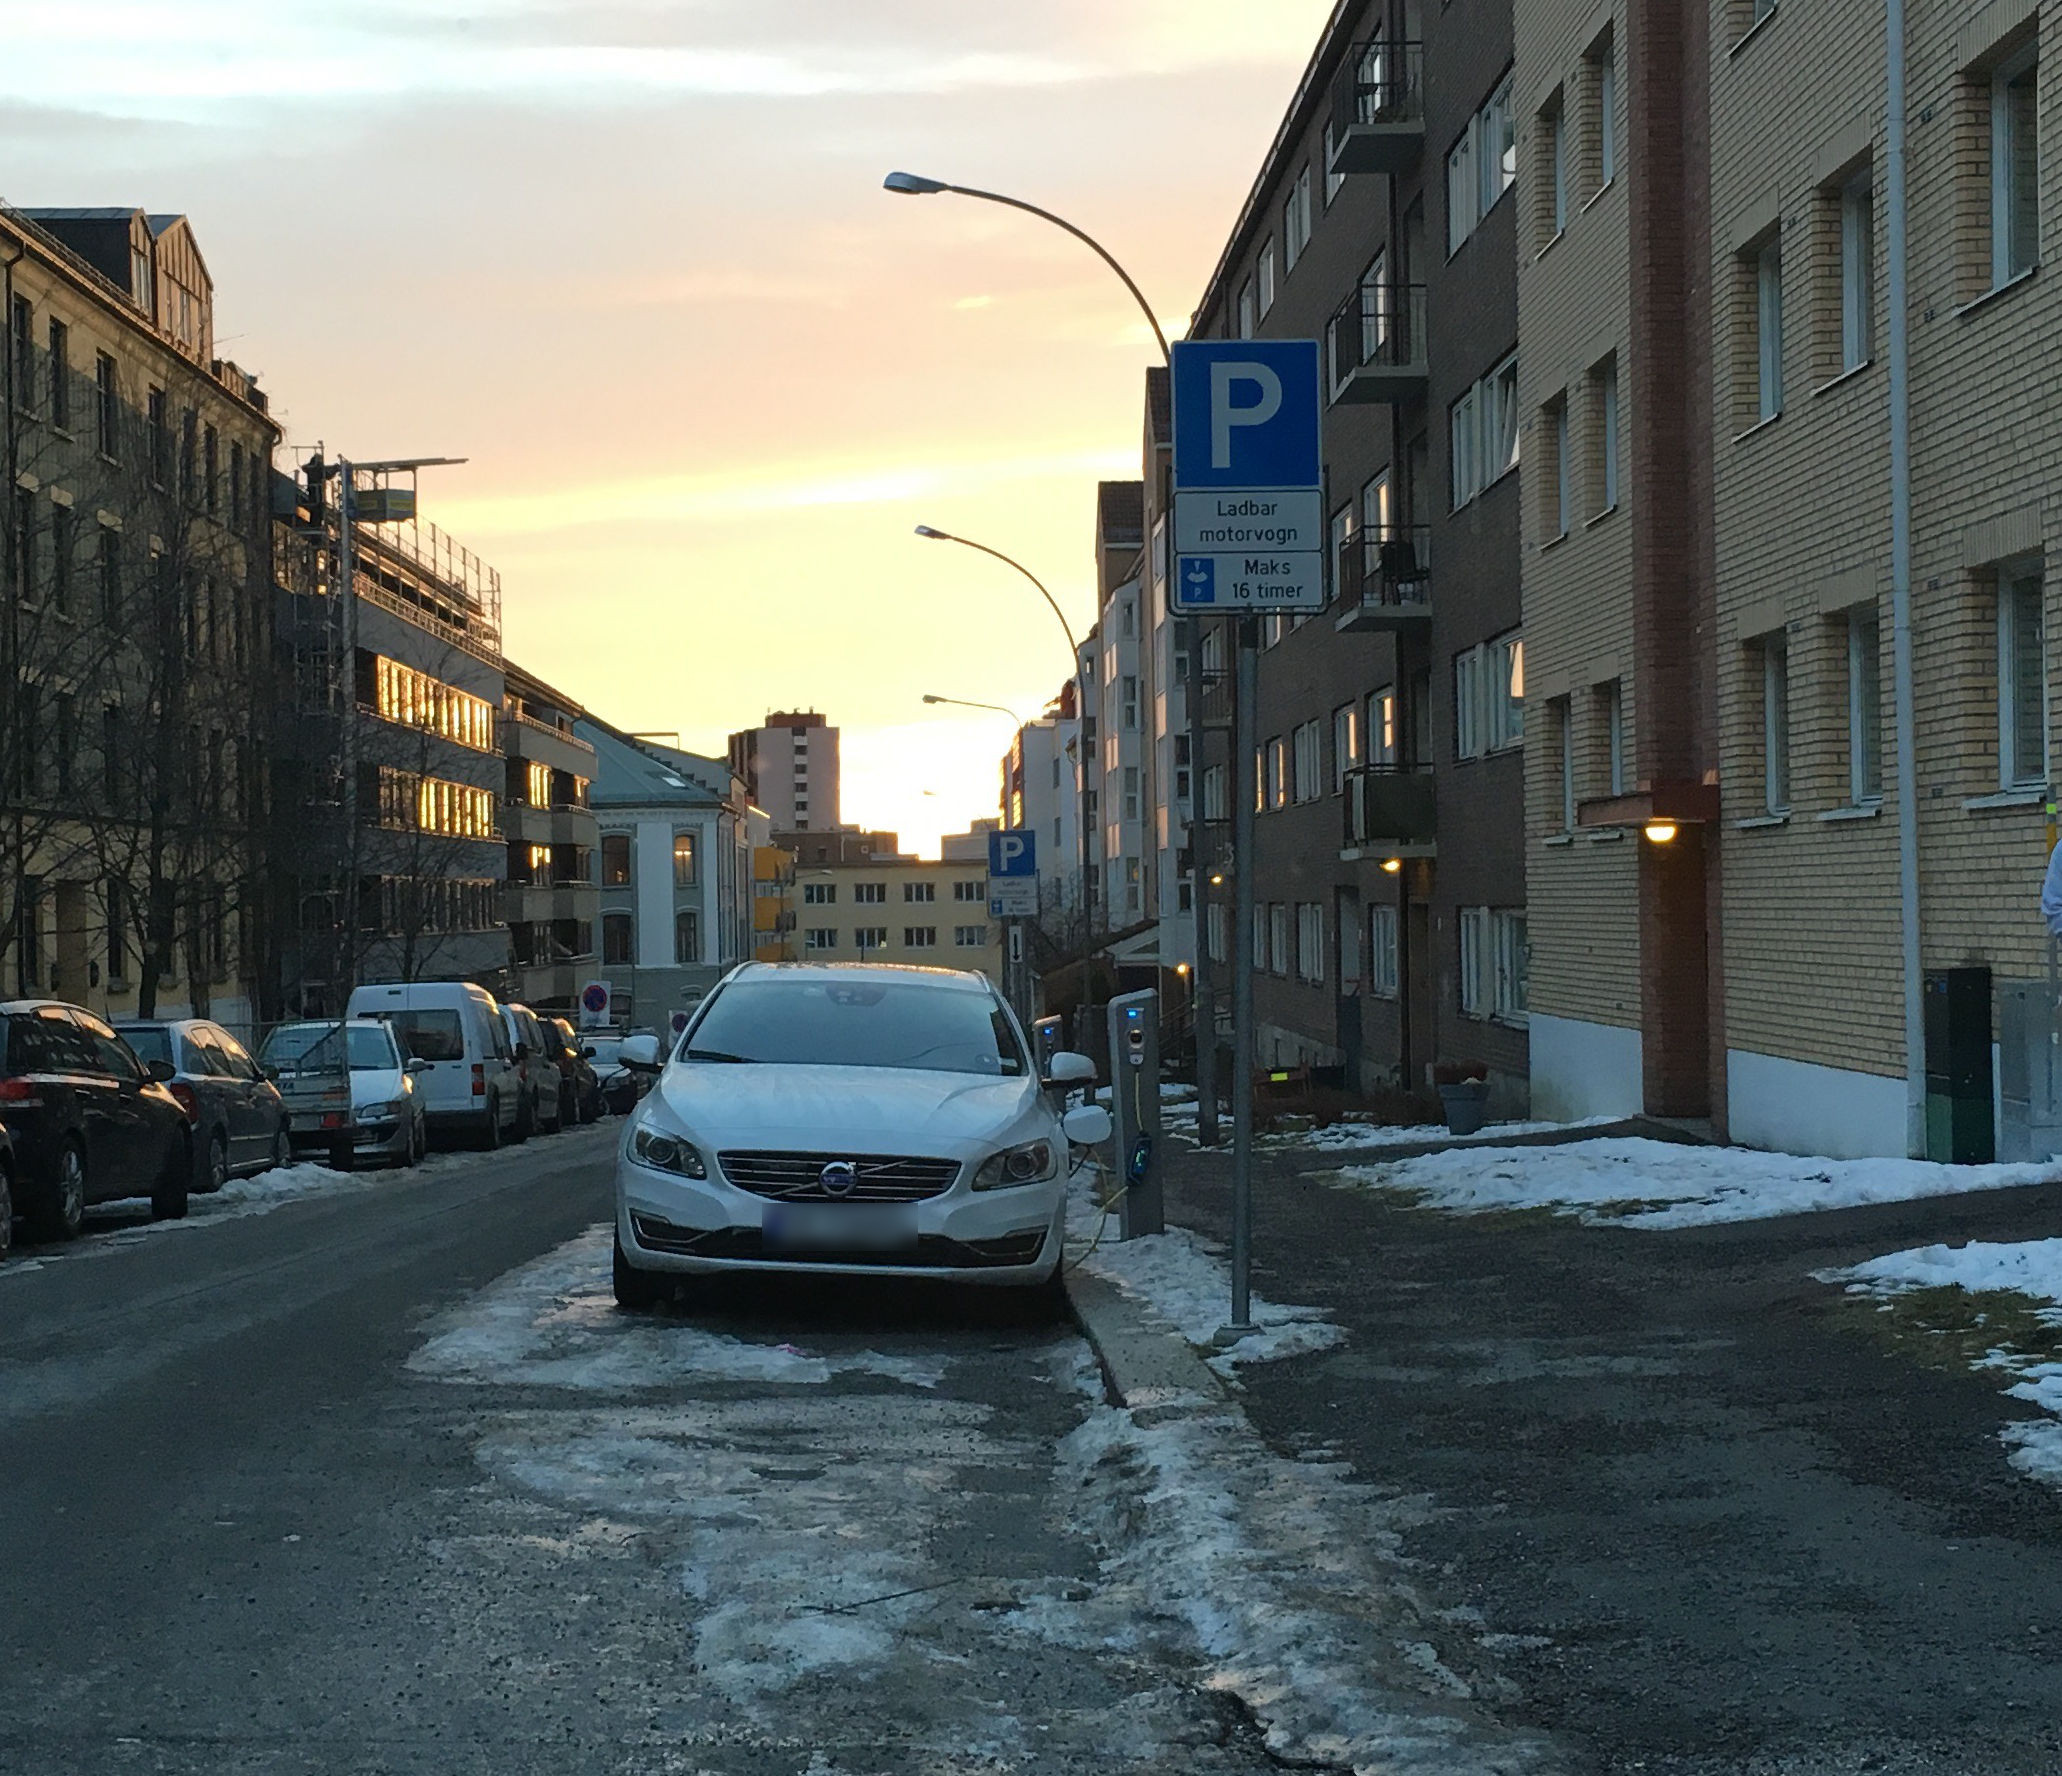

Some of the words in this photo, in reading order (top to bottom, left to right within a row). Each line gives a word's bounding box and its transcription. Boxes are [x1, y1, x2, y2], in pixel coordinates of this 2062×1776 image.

[1210, 361, 1283, 469] P
[1217, 499, 1278, 517] Ladbar
[1200, 526, 1298, 545] motorvogn
[1244, 559, 1291, 576] Maks
[1232, 582, 1250, 599] 16
[1257, 582, 1303, 599] timer
[1000, 836, 1024, 871] P
